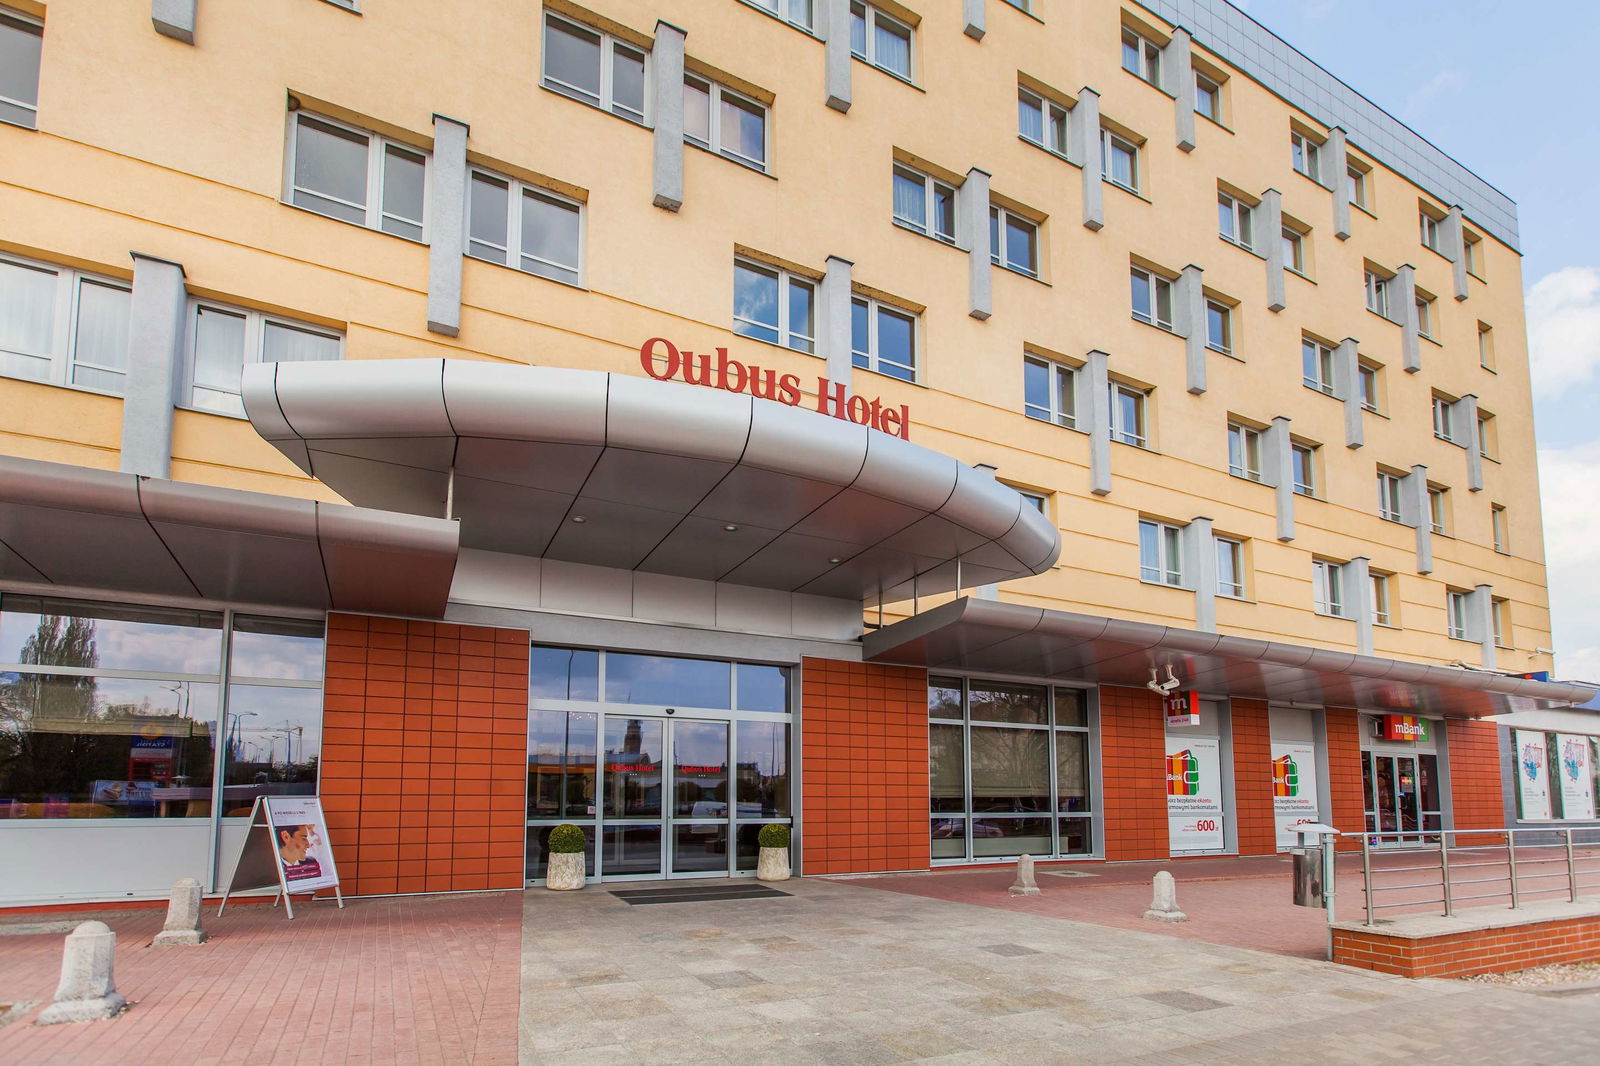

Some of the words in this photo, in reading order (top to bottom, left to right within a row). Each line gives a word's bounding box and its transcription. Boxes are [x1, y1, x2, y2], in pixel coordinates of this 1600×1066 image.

[640, 337, 801, 407] Qubus
[816, 376, 910, 441] Hotel
[1170, 698, 1187, 710] m
[1394, 722, 1425, 736] mBank
[1197, 819, 1215, 832] 600
